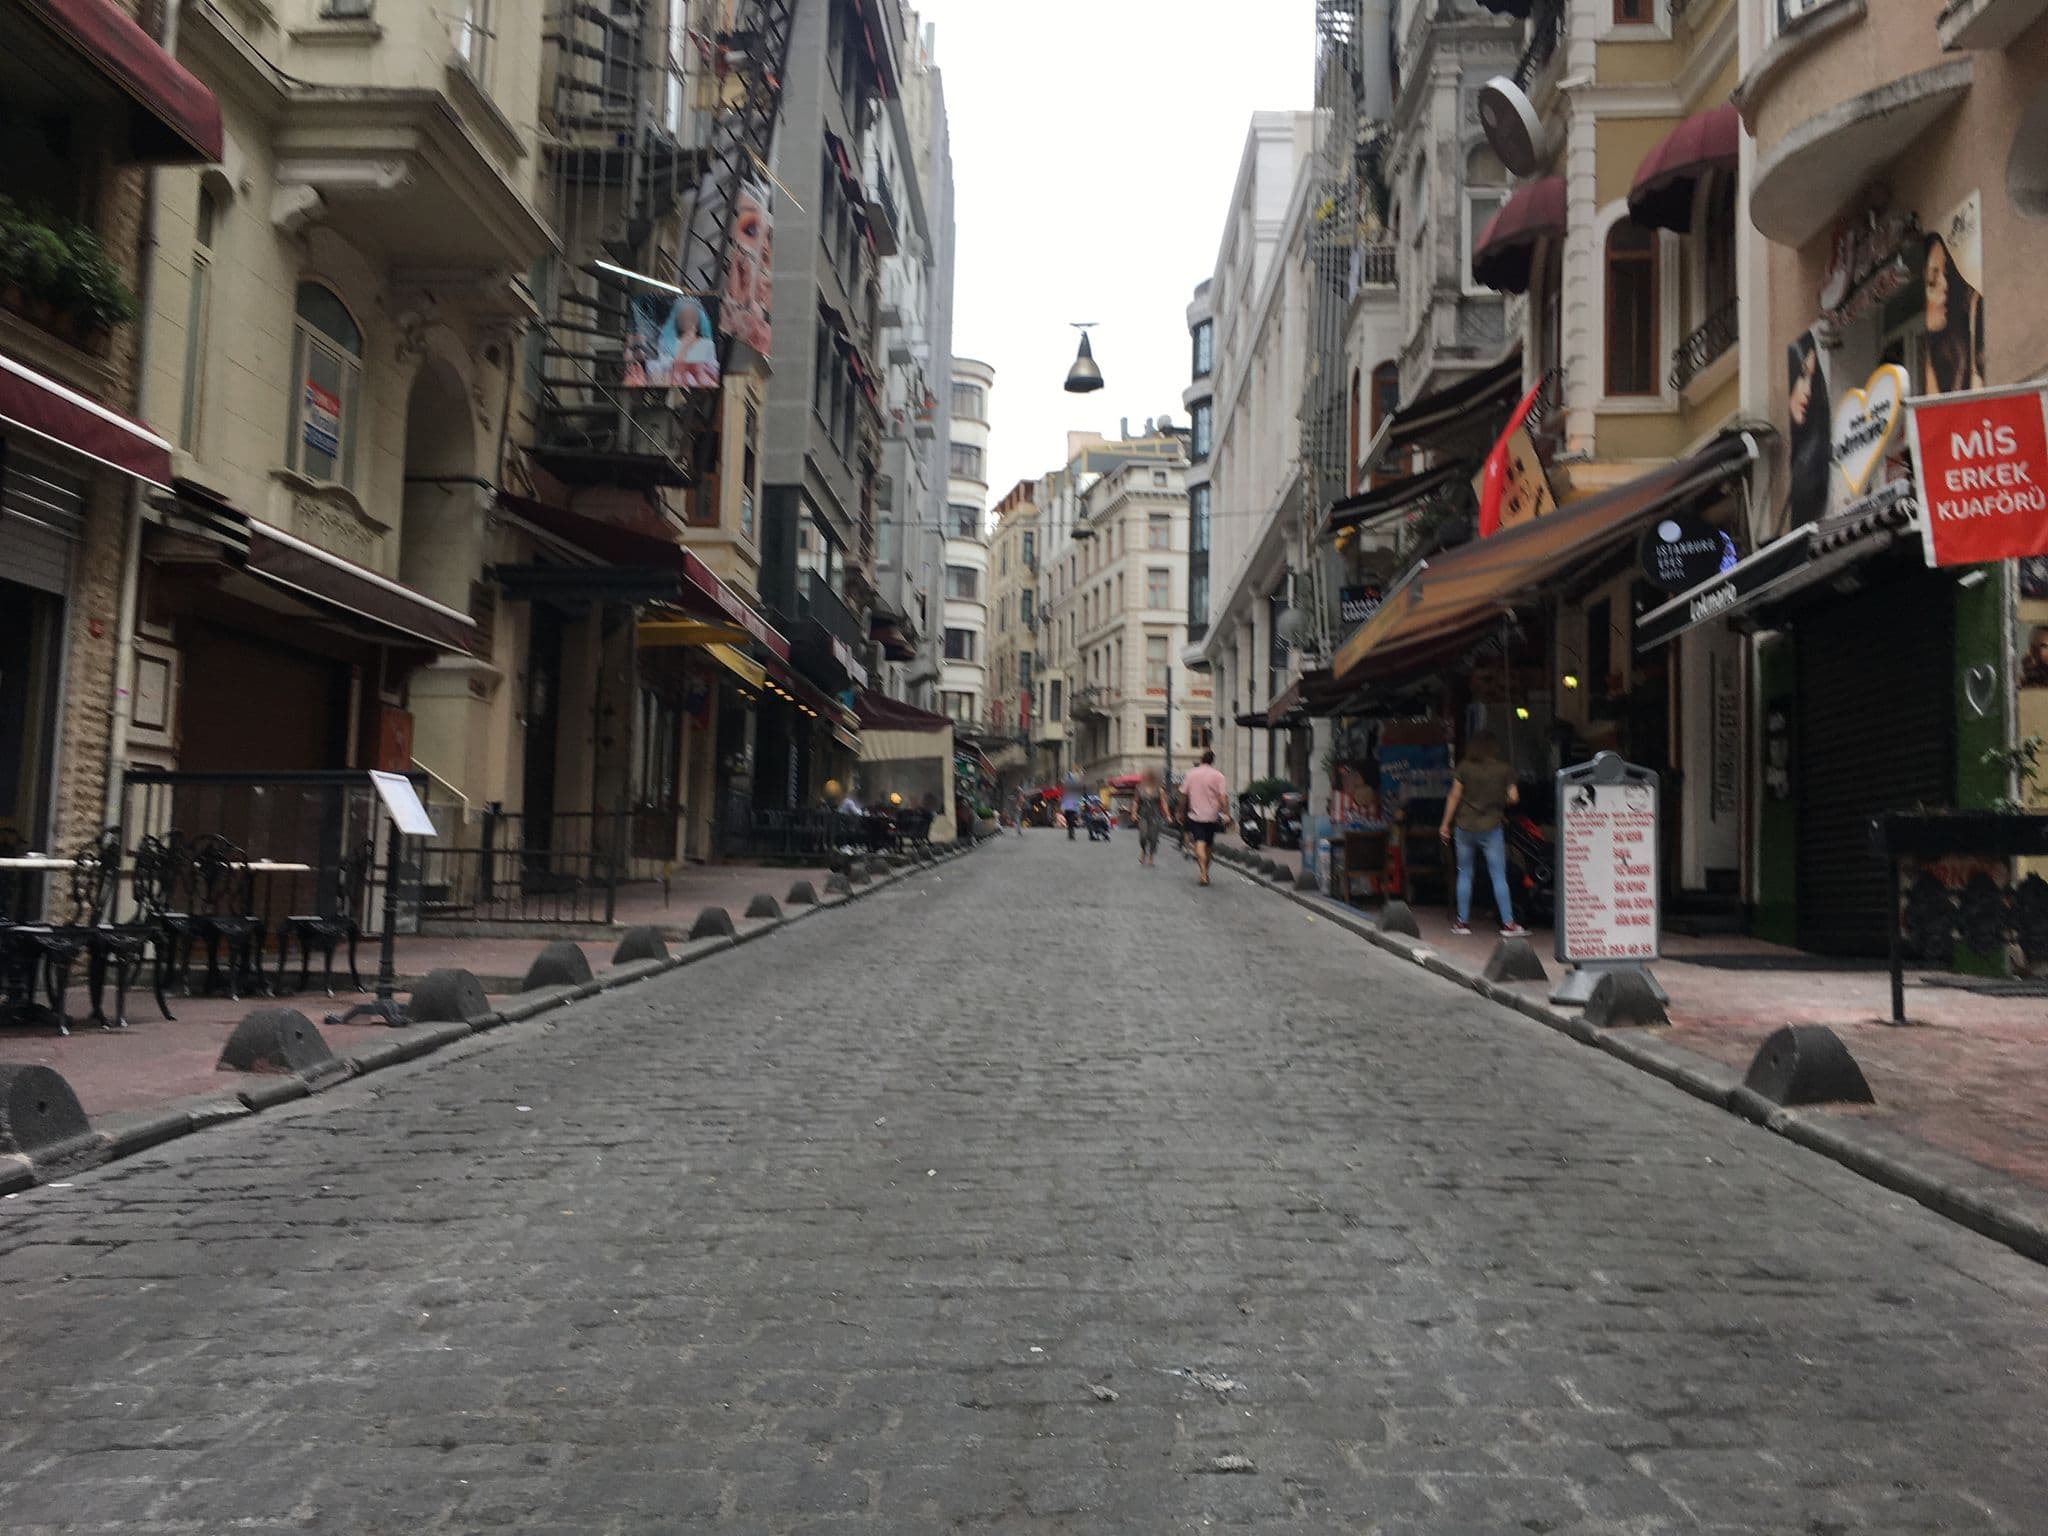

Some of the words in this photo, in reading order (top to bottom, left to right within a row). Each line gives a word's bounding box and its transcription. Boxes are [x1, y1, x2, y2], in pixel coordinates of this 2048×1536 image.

[1950, 418, 2017, 461] MİS
[1944, 460, 2032, 492] ERKEK
[1936, 486, 2046, 521] KUAFÖRÜ
